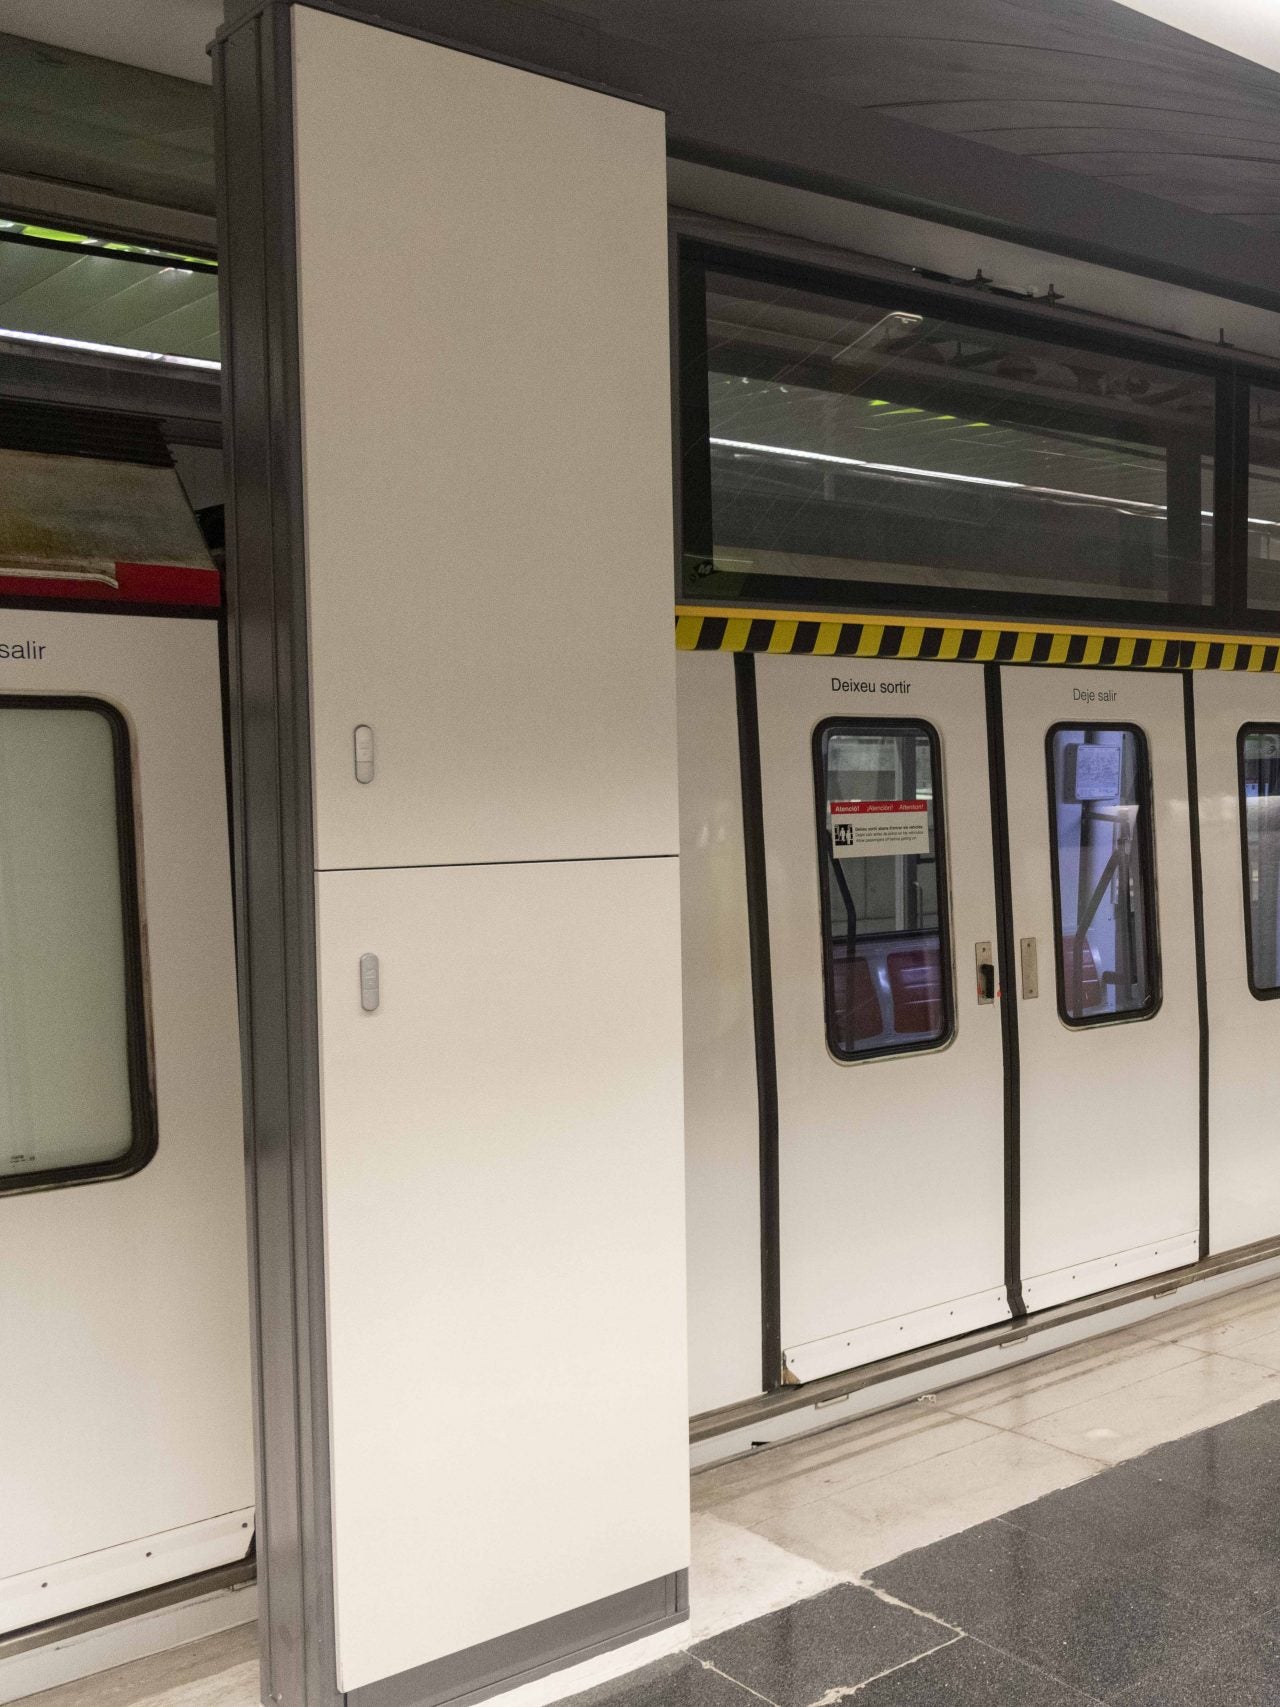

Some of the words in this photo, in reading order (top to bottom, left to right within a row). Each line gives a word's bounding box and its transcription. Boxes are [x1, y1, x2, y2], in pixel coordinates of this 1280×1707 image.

[0, 640, 46, 660] salir
[831, 677, 876, 693] Deixeu
[880, 680, 911, 694] sortir
[1072, 688, 1095, 704] Deje
[1097, 689, 1117, 702] salir
